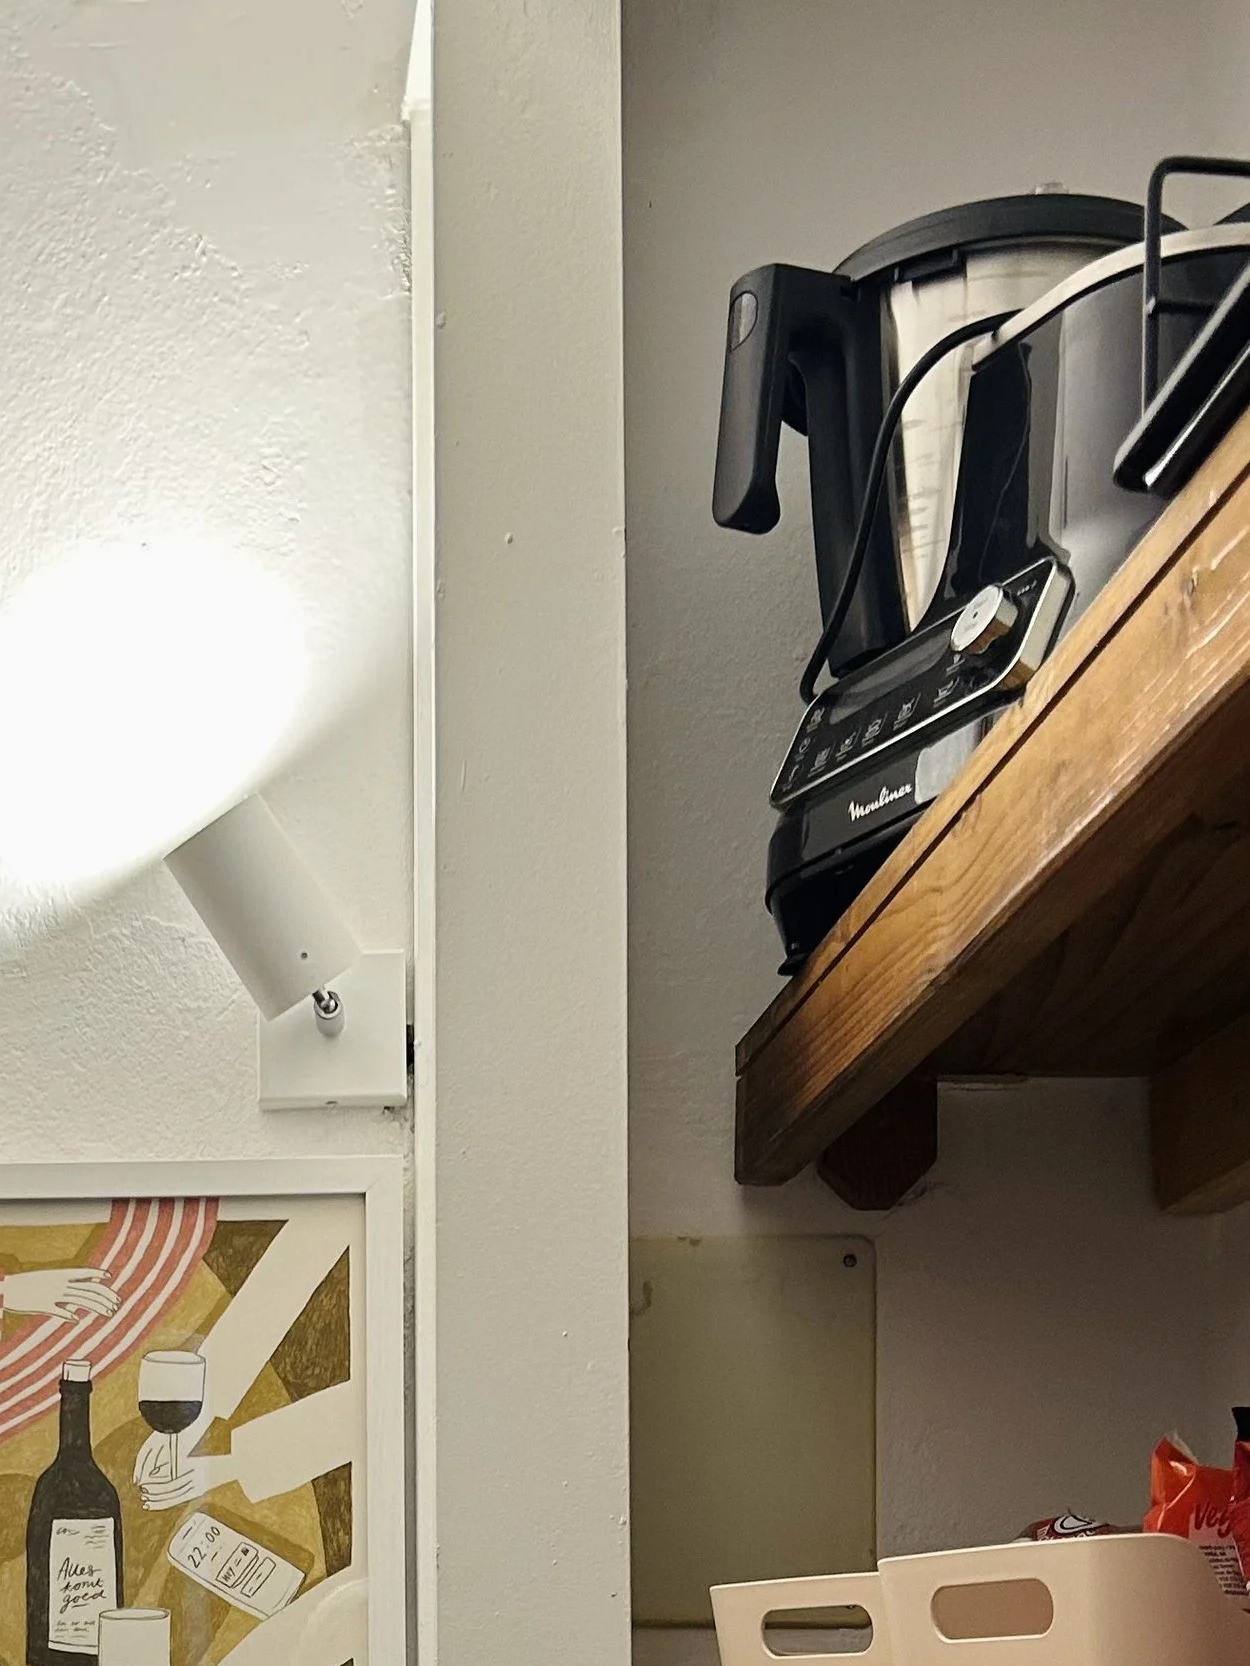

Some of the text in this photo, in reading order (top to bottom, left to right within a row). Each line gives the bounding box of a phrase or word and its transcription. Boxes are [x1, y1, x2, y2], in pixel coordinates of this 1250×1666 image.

[848, 783, 913, 822] Moulinex
[187, 1525, 221, 1569] 22:00
[59, 1589, 107, 1615] goed
